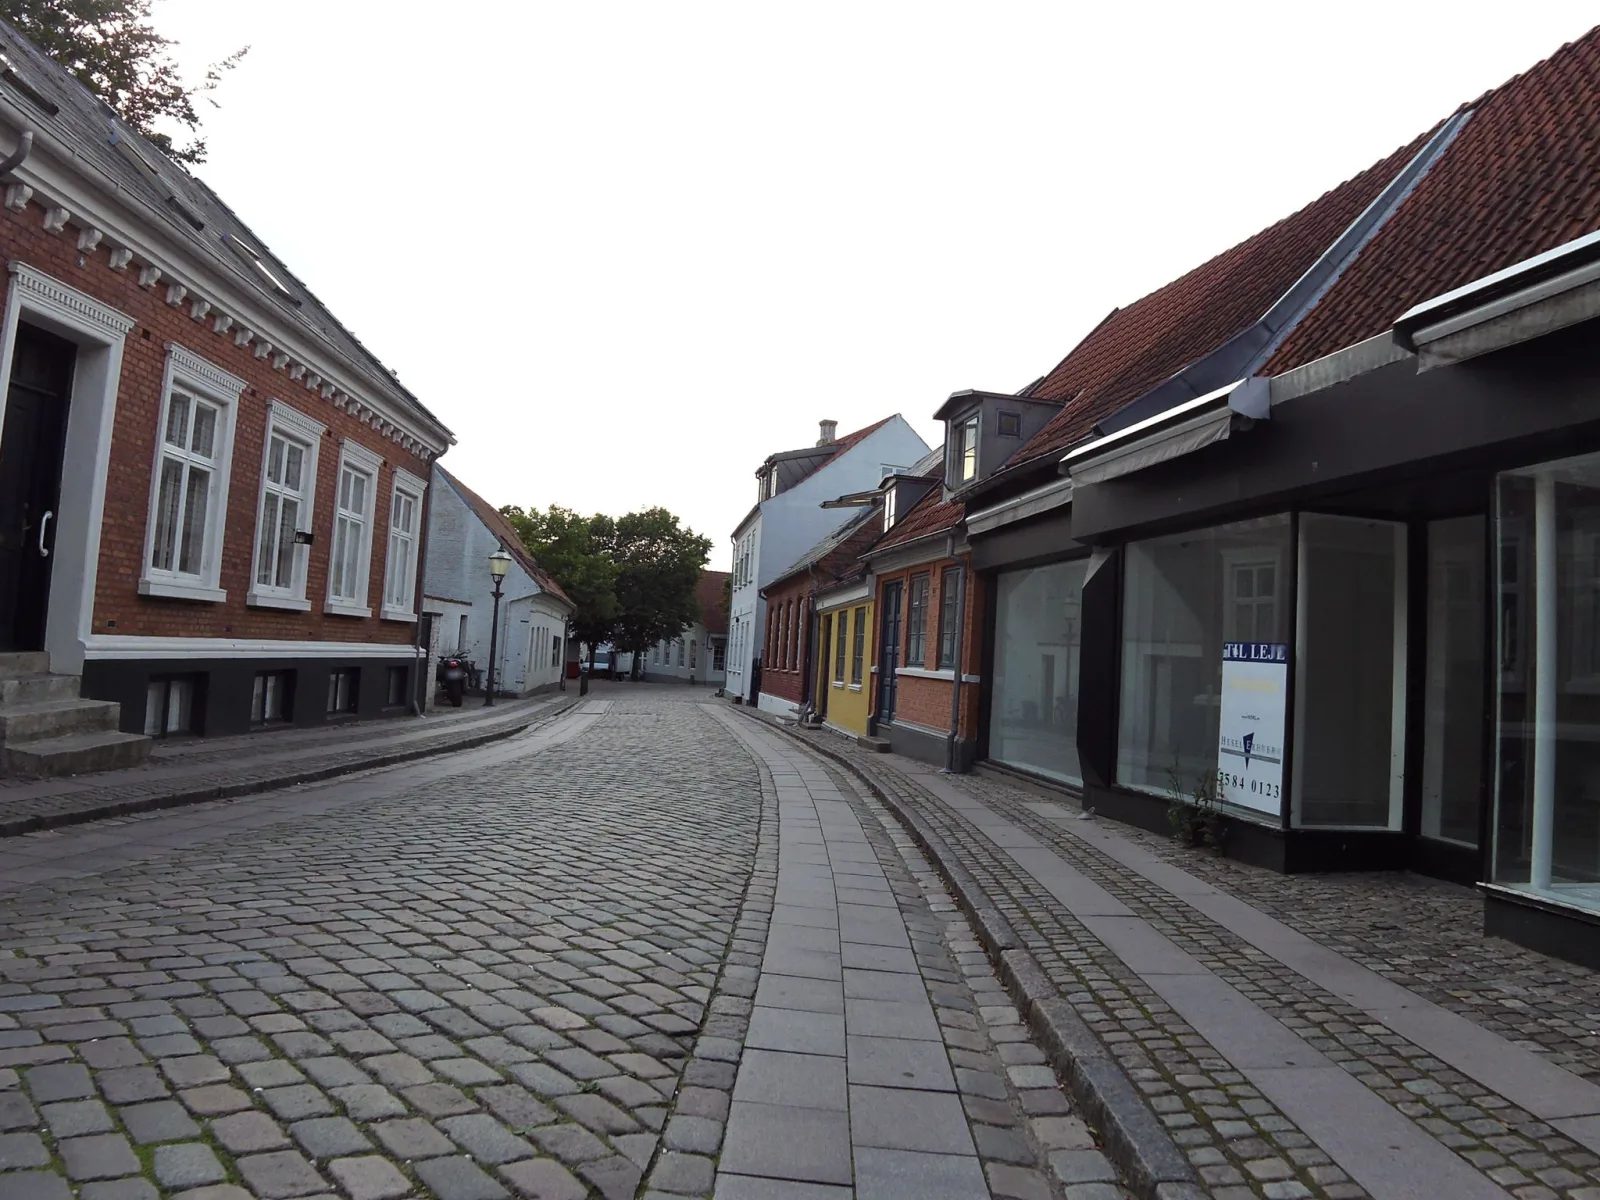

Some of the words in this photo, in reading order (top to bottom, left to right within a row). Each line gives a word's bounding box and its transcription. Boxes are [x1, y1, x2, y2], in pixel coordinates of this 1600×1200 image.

[1225, 643, 1247, 659] TIL
[1250, 644, 1285, 660] LEJE
[1251, 779, 1280, 799] 0123
